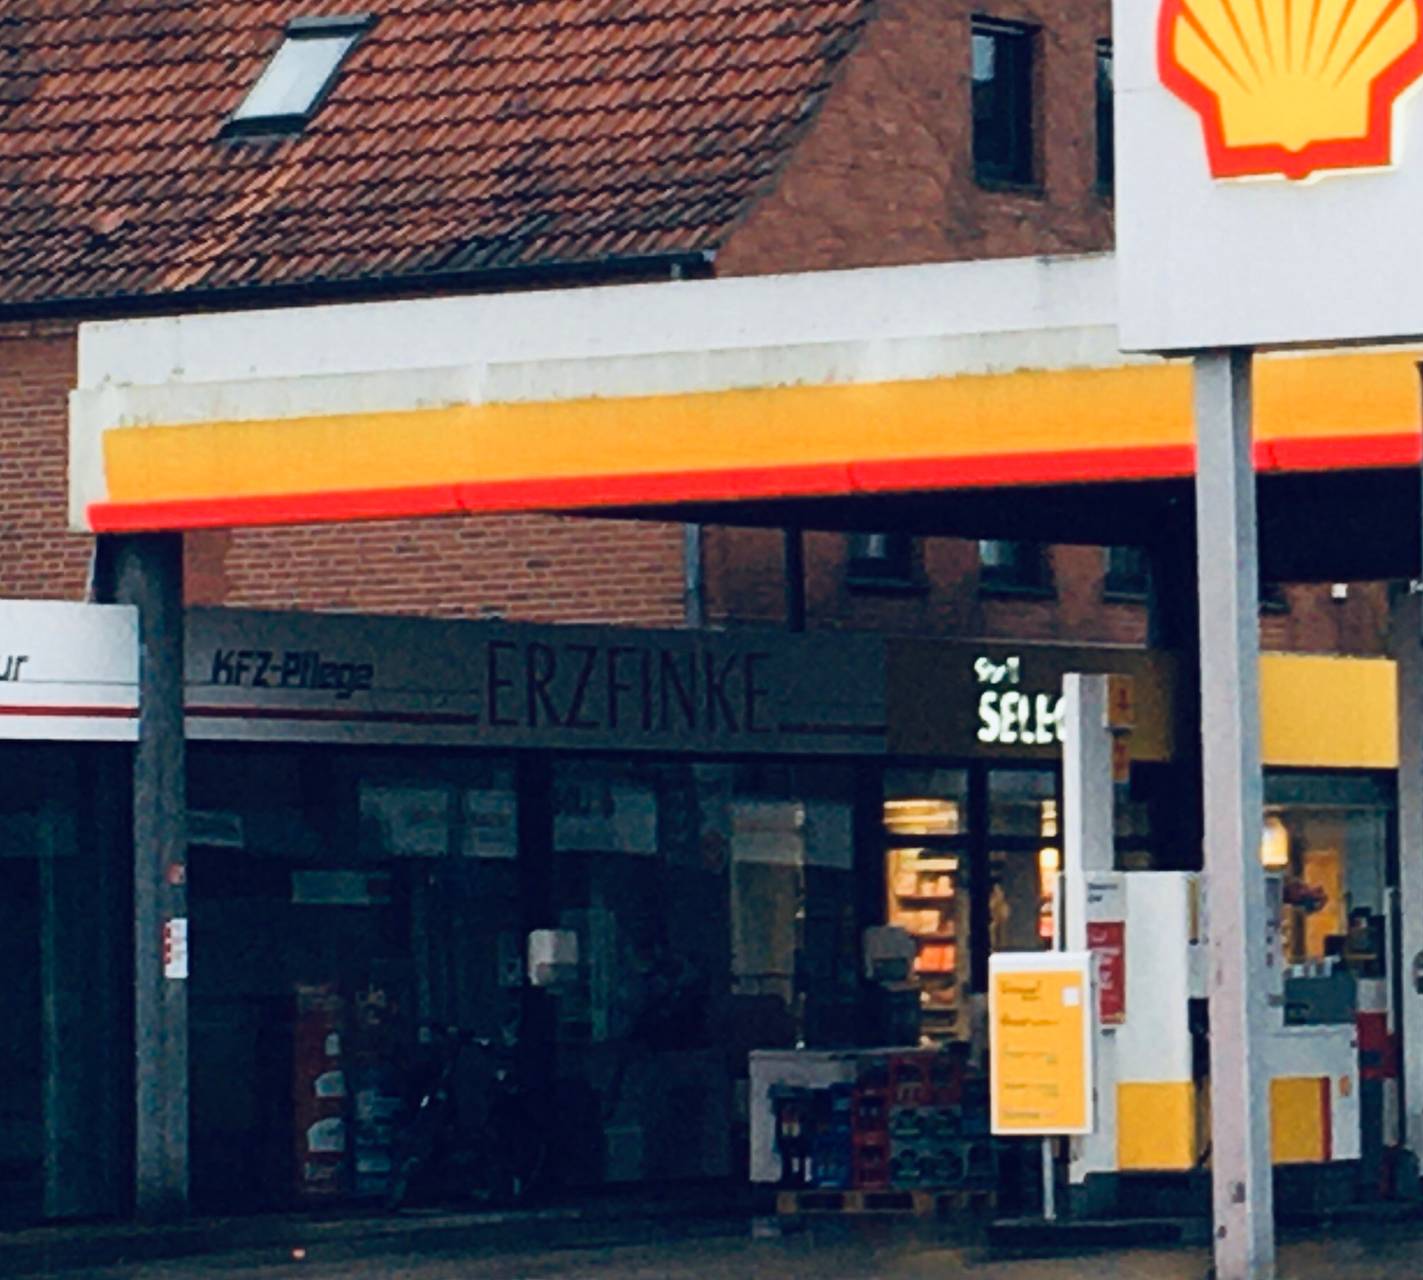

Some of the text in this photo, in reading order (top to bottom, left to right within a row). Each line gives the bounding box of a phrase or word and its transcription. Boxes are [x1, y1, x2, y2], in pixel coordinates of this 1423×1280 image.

[212, 648, 373, 699] KFZ-Pflege
[488, 640, 769, 733] ERZFINKE
[977, 691, 1064, 743] SELEC
